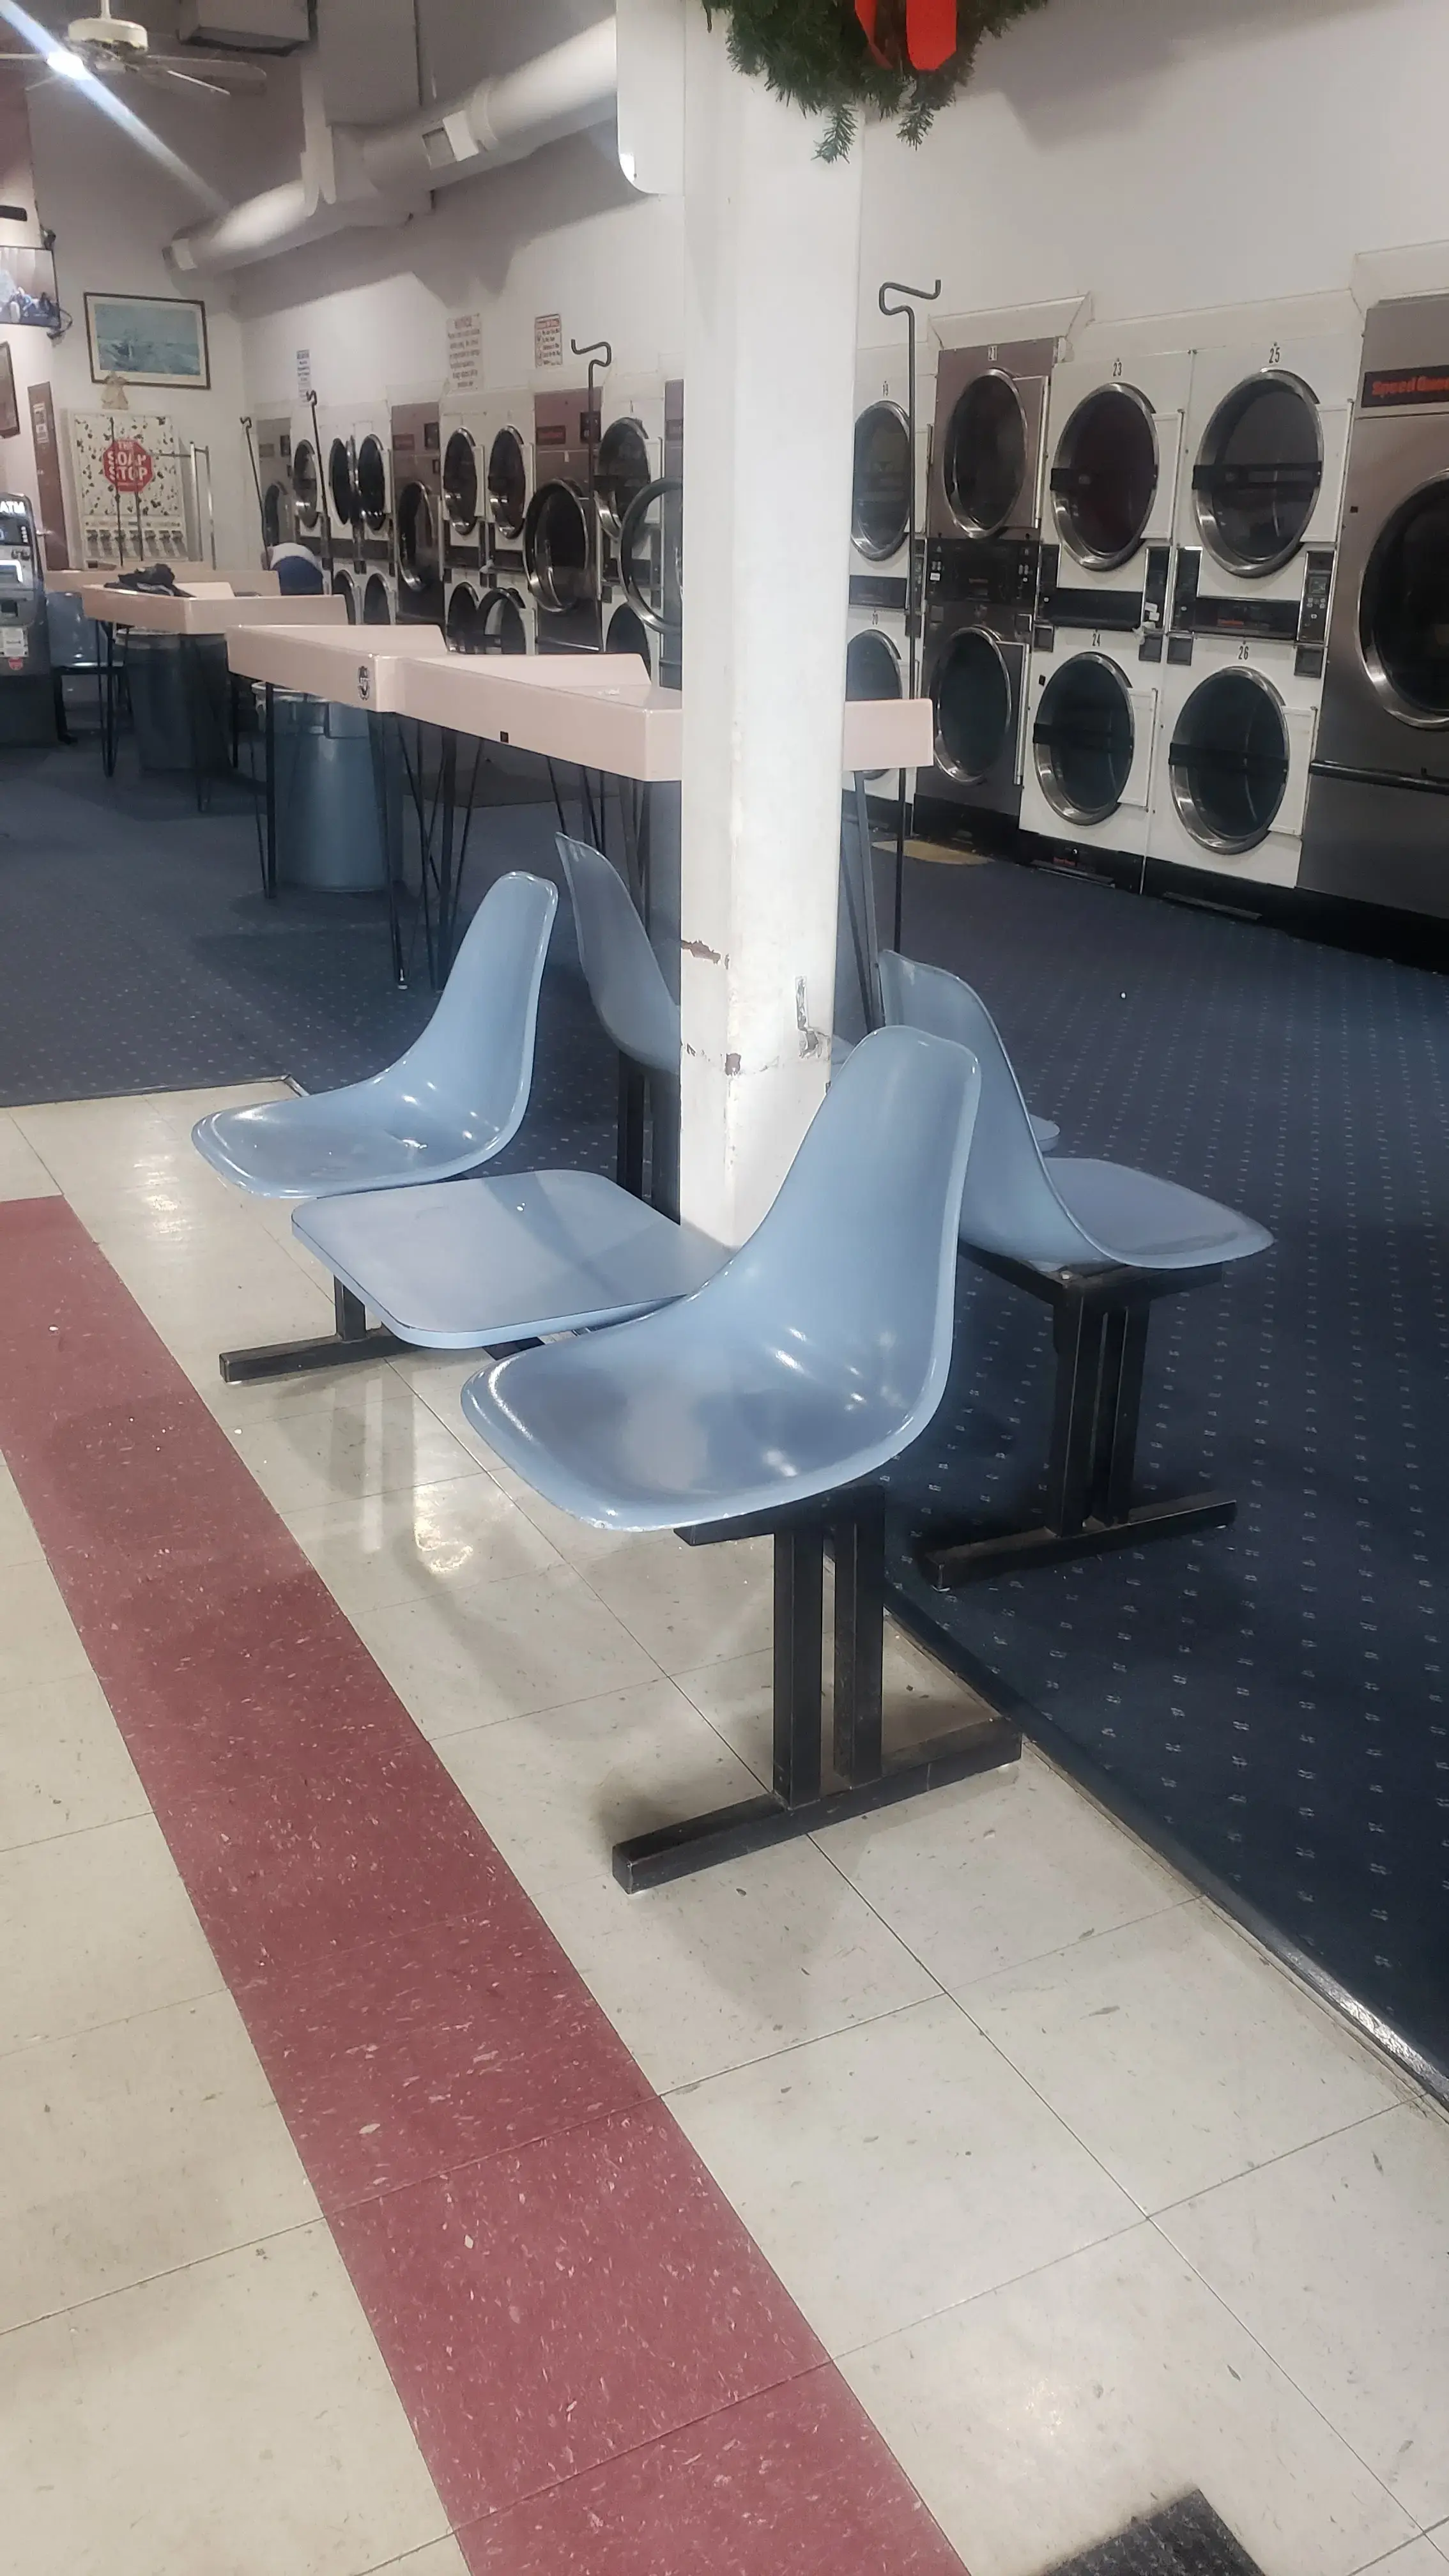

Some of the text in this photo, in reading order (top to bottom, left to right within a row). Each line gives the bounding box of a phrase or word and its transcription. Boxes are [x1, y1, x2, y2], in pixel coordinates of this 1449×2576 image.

[1269, 347, 1280, 364] 25
[1112, 362, 1122, 376] 23
[1372, 378, 1416, 399] Speed
[107, 450, 146, 466] SOAP
[109, 466, 148, 480] STOP
[0, 501, 26, 514] ATM
[1092, 633, 1101, 647] 24
[1238, 646, 1248, 661] 26
